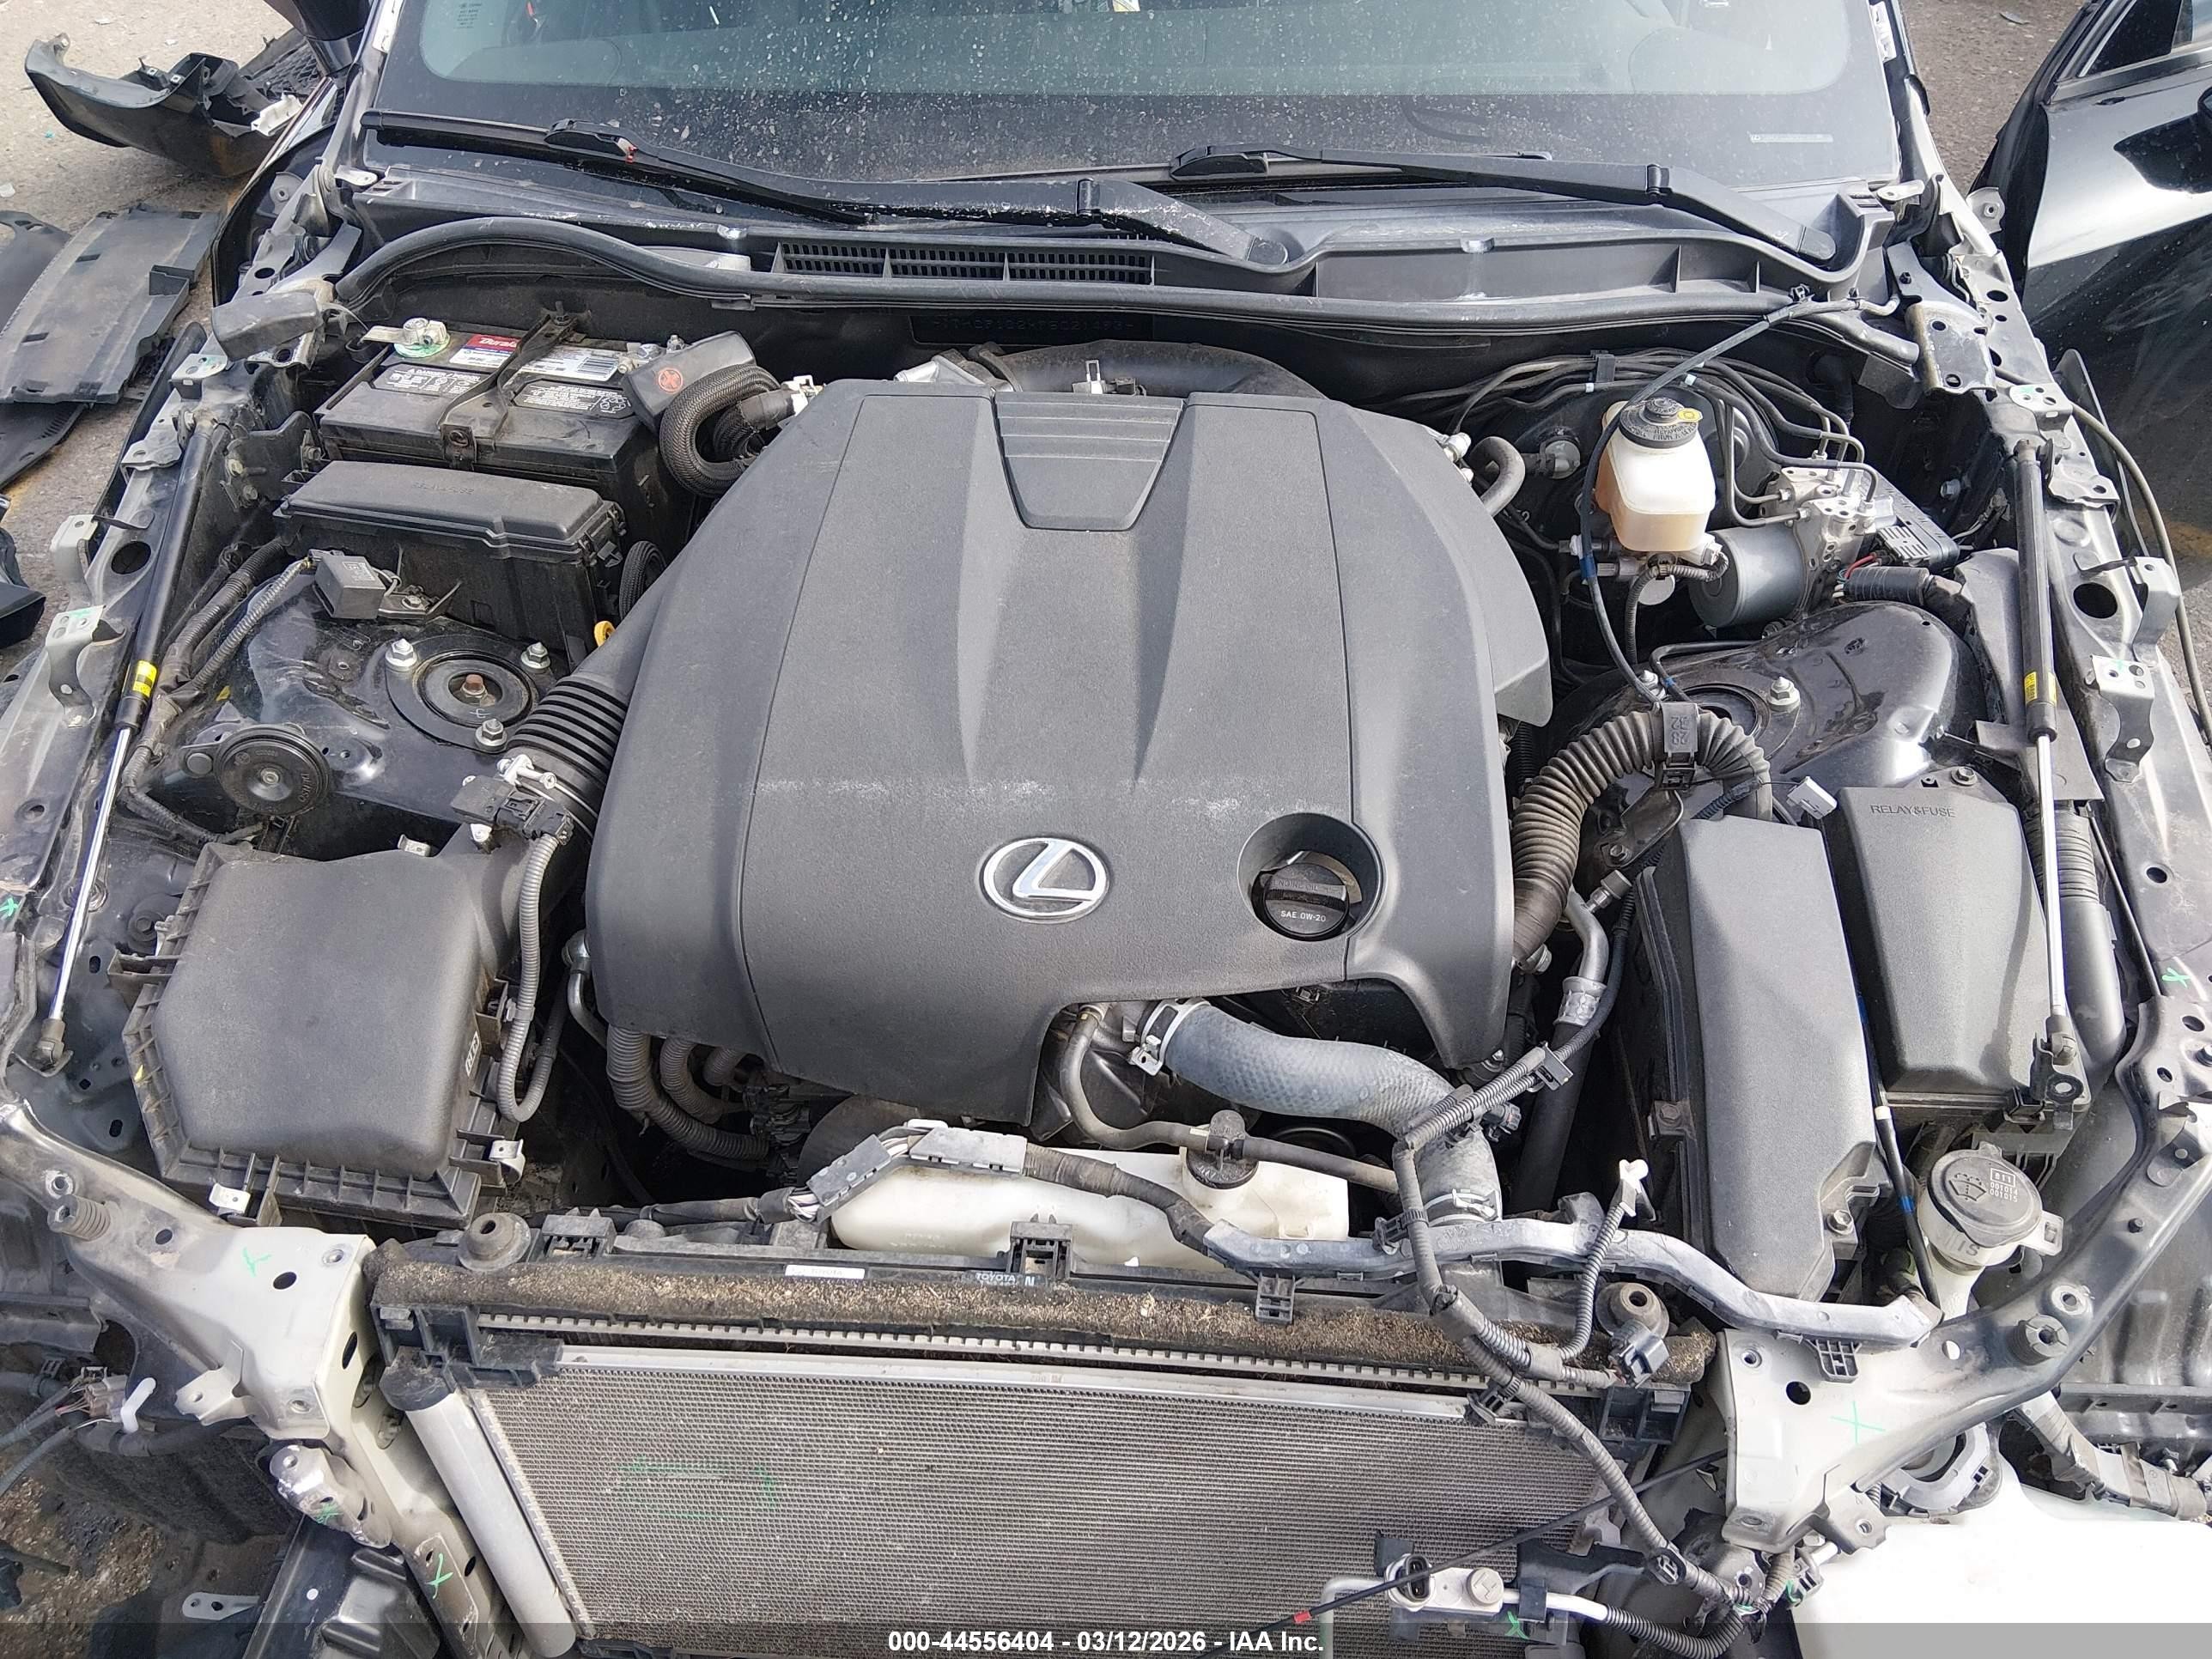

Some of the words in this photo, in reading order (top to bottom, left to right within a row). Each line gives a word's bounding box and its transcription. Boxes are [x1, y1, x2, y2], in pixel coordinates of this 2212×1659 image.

[1869, 805, 1957, 818] RELAY&FUSE
[1280, 910, 1297, 919] SAE
[1300, 912, 1327, 922] 0W-20
[1990, 1181, 2018, 1196] 001014
[1990, 1188, 2018, 1203] 001015
[975, 1272, 1016, 1282] TOYOTA
